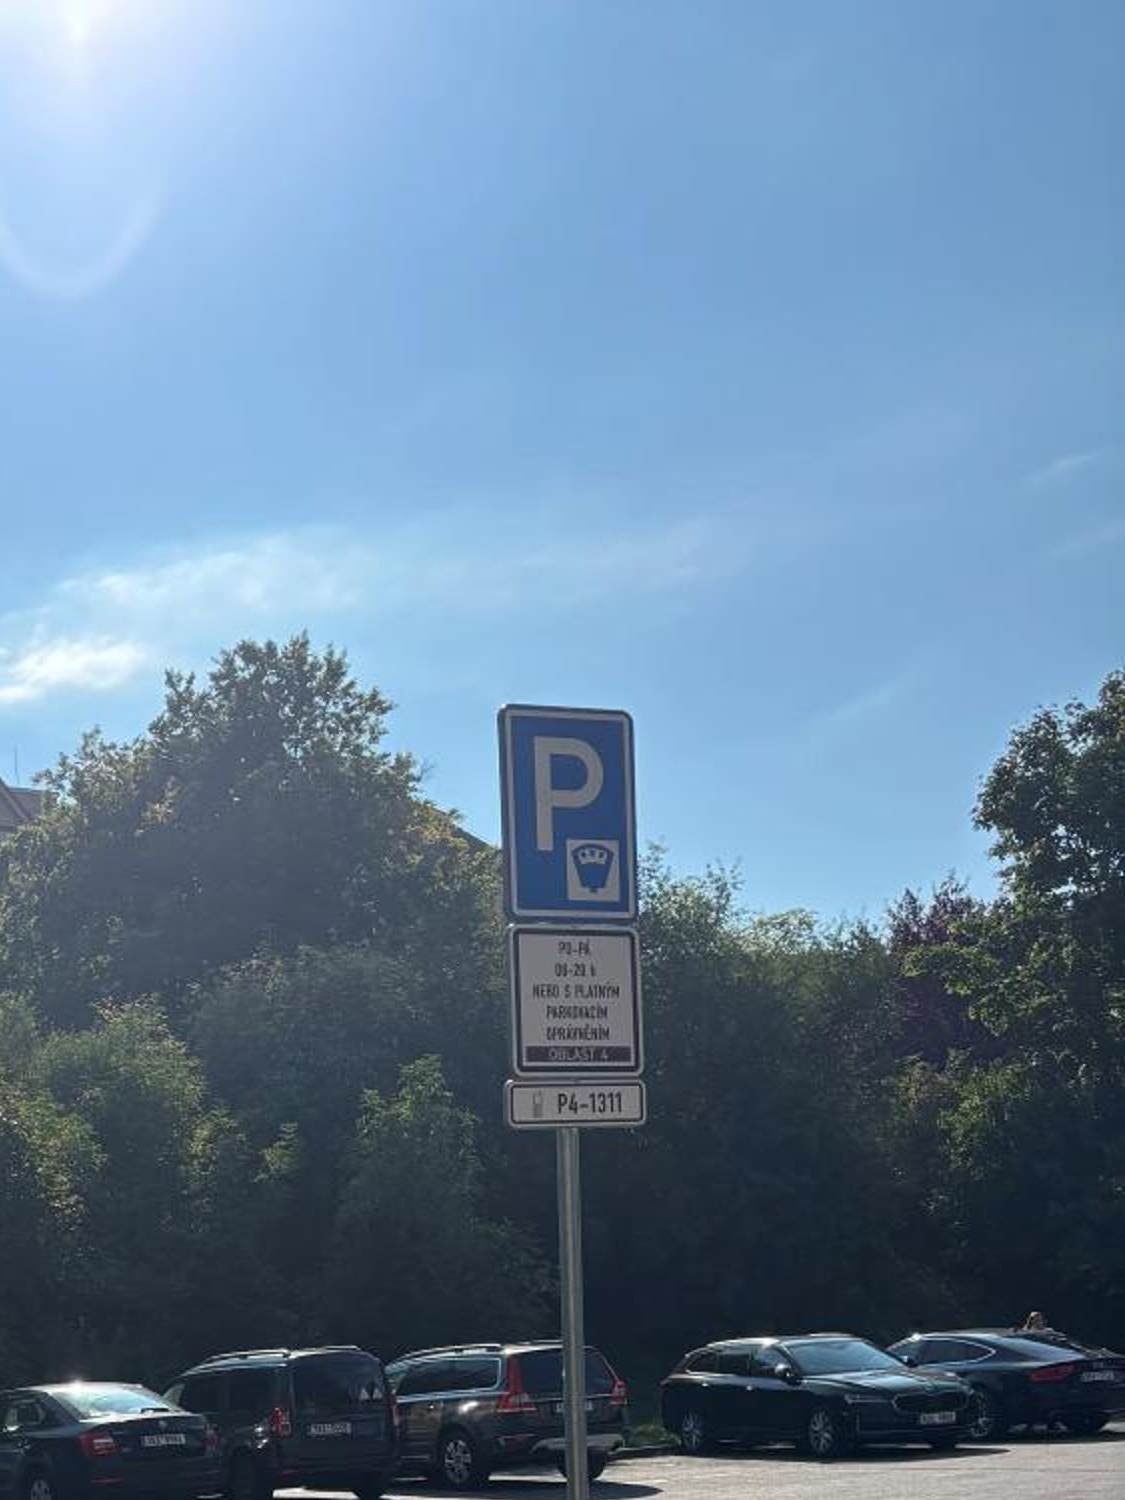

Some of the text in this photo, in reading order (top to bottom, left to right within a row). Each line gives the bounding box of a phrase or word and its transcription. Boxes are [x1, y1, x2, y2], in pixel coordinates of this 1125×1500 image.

[533, 736, 603, 851] P
[532, 981, 620, 998] NEBO S PLATNÝM
[549, 1048, 595, 1061] OBLAST
[558, 1092, 622, 1114] P4-1311
